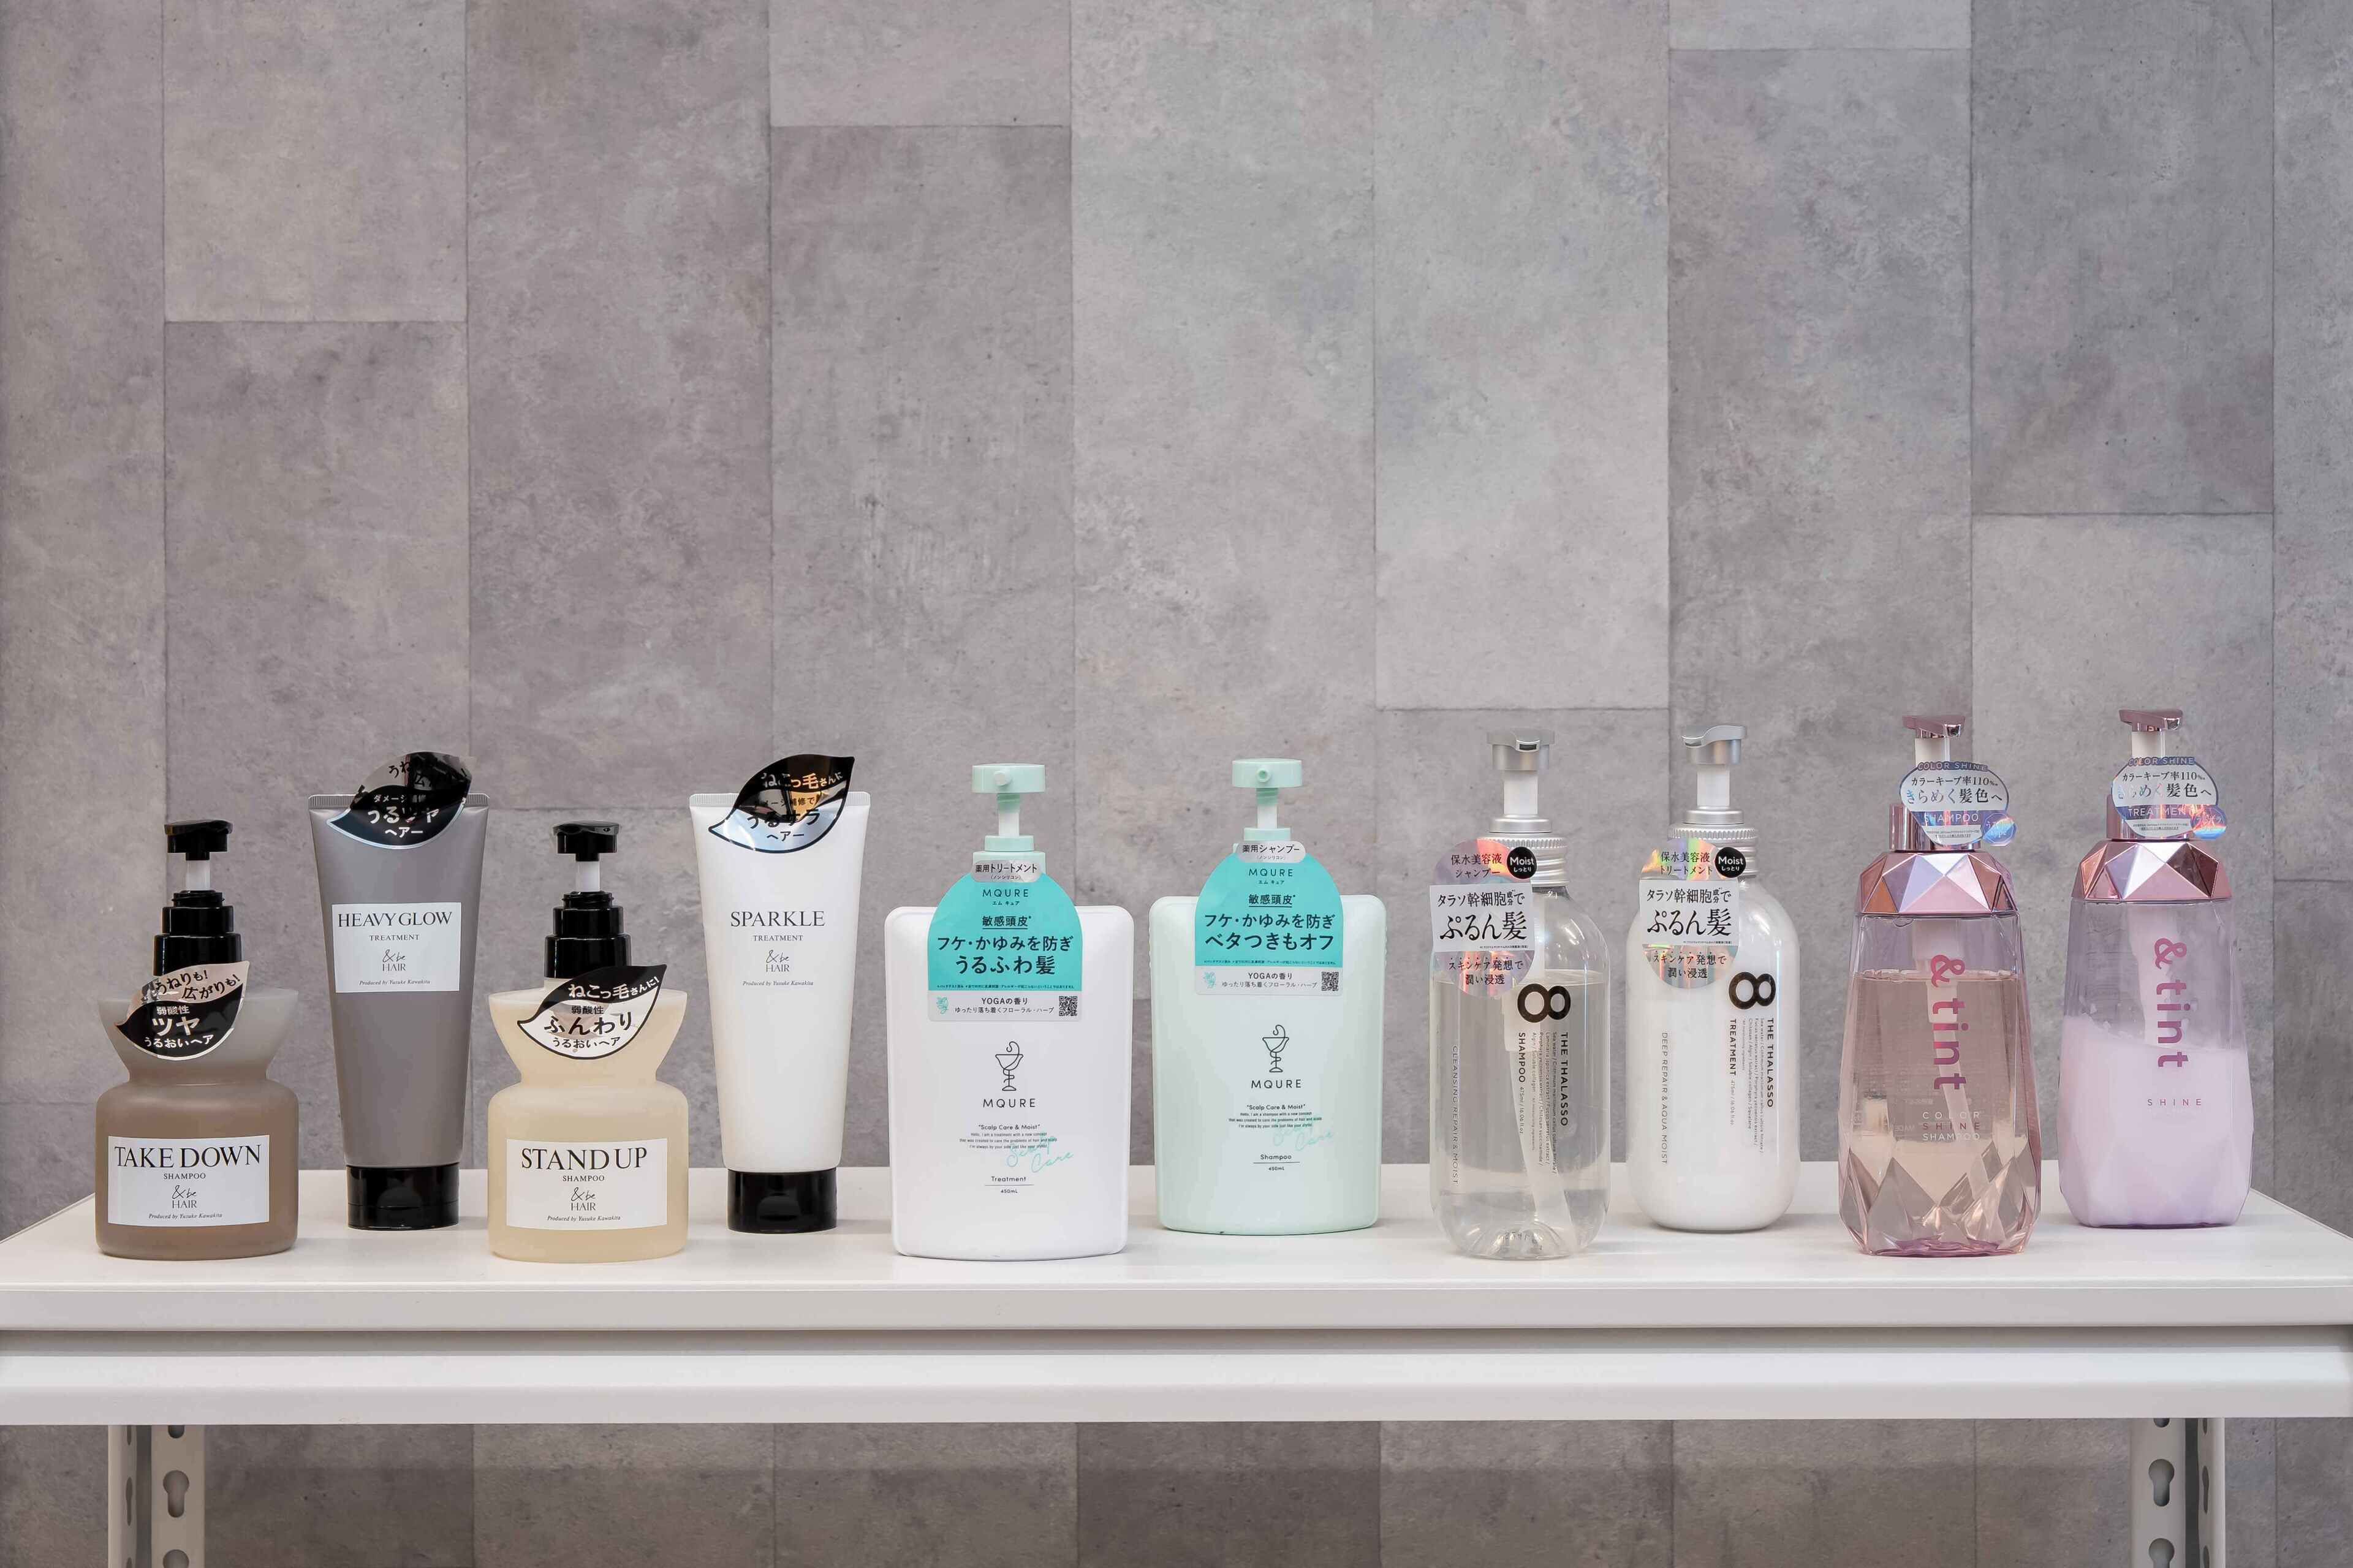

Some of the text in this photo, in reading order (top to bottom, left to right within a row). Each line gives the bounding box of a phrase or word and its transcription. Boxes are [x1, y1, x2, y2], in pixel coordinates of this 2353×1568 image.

[1918, 762, 1988, 771] COLOR SHINE
[2128, 757, 2158, 766] COLOR
[1906, 788, 2003, 804] きらめく髪色へ
[2118, 784, 2211, 799] めく髪色へ
[1923, 813, 1979, 822] SHAMPOO
[385, 827, 423, 838] ヘアー
[767, 831, 805, 841] ヘアー
[1242, 844, 1300, 854] 薬用シャンプー
[1451, 853, 1502, 865] 保水美容液
[1510, 857, 1534, 866] Moist
[1661, 852, 1710, 863] 保水美容液
[1718, 856, 1744, 865] Moist
[975, 863, 1037, 873] 薬用トリートメント
[1249, 868, 1294, 877] MQURE
[1456, 868, 1500, 878] シャンプー
[1660, 865, 1713, 875] トリートメント
[983, 889, 1029, 898] MQURE
[338, 911, 452, 927] HEAVY GLOW
[730, 911, 826, 926] SPARKLE
[1205, 913, 1335, 929] フケ・かゆみを防ぎ
[1647, 909, 1732, 936] ぷるん髪
[1440, 911, 1527, 941] ぷるん髪
[938, 936, 1074, 952] フケ・かゆみを防ぎ
[1205, 932, 1334, 950] ベタつきもオフ
[956, 955, 1055, 975] うるふわ髪
[1653, 955, 1727, 964] スキンケア発想で
[382, 963, 407, 972] HAIR
[1449, 960, 1523, 971] スキンケア発想で
[1668, 968, 1707, 979] 潤い浸透
[1466, 974, 1505, 985] 潤い浸透
[568, 976, 660, 999] ねこっ毛さんに!
[156, 1005, 190, 1015] 弱酸性
[571, 1006, 604, 1014] 弱酸性
[152, 1016, 200, 1037] ツヤ
[544, 1012, 631, 1036] ふんわり
[145, 1034, 214, 1048] うるおいヘア
[553, 1037, 621, 1048] うるおいヘア
[1251, 1079, 1302, 1089] MQURE
[983, 1099, 1036, 1108] MQURE
[114, 1145, 262, 1168] TAKE DOWN
[521, 1147, 647, 1170] STAND UP
[172, 1200, 197, 1209] HAIR
[571, 1202, 596, 1211] HAIR
